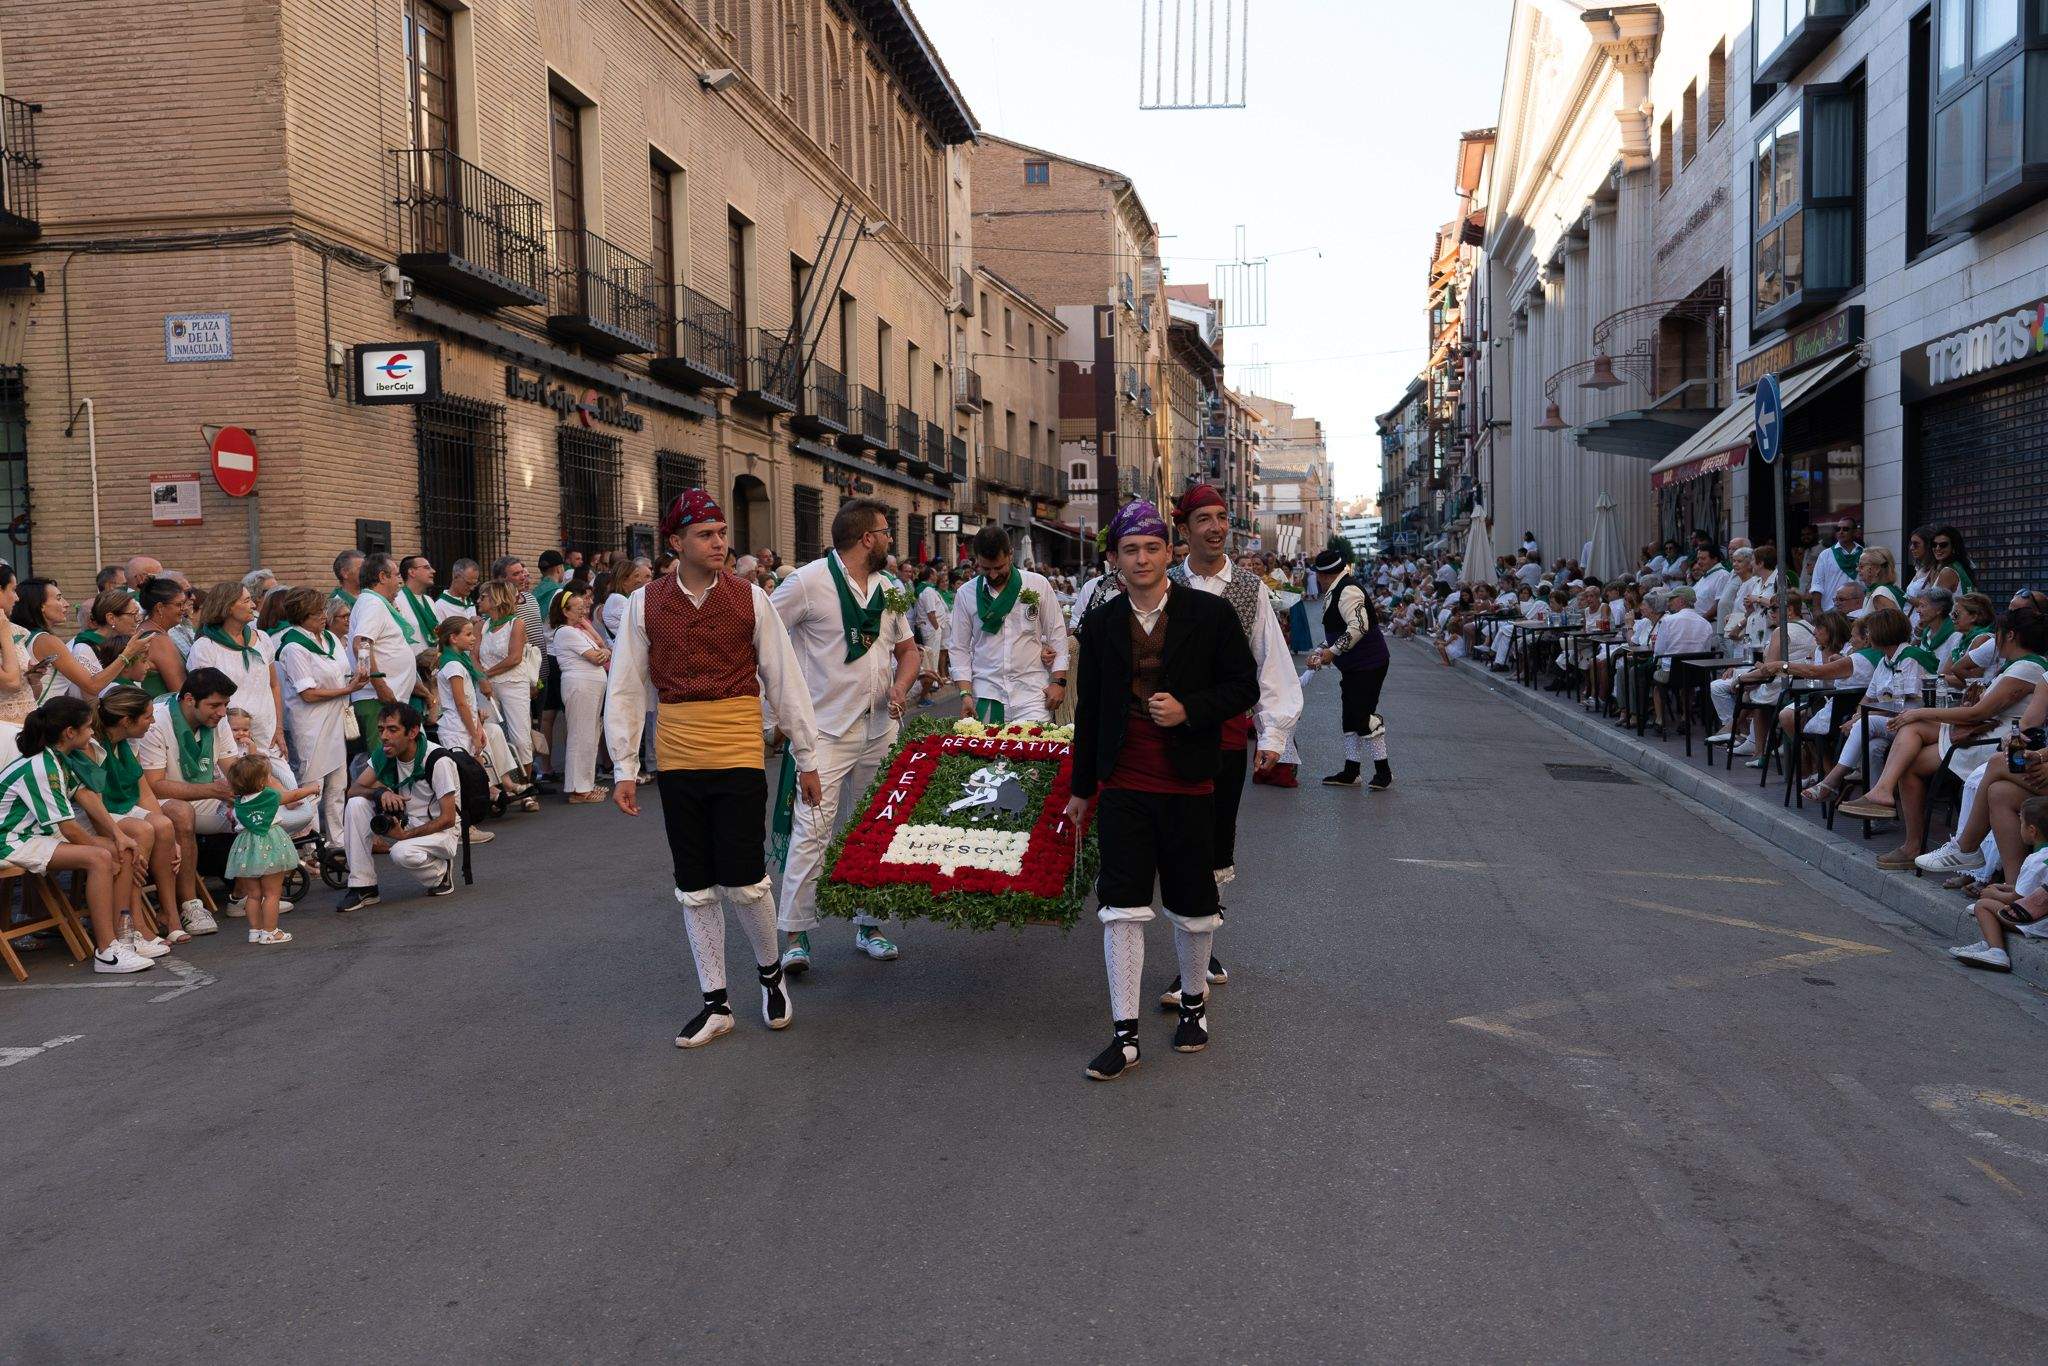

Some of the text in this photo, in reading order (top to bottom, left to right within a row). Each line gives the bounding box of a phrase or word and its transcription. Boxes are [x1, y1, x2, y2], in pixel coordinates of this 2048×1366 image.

[192, 321, 220, 331] PLAZA
[188, 332, 219, 343] DE LA
[174, 343, 224, 355] INMACULADA
[376, 382, 414, 391] iberCaja
[941, 738, 1070, 755] RECREATIVA
[908, 841, 1004, 855] HUESCA
